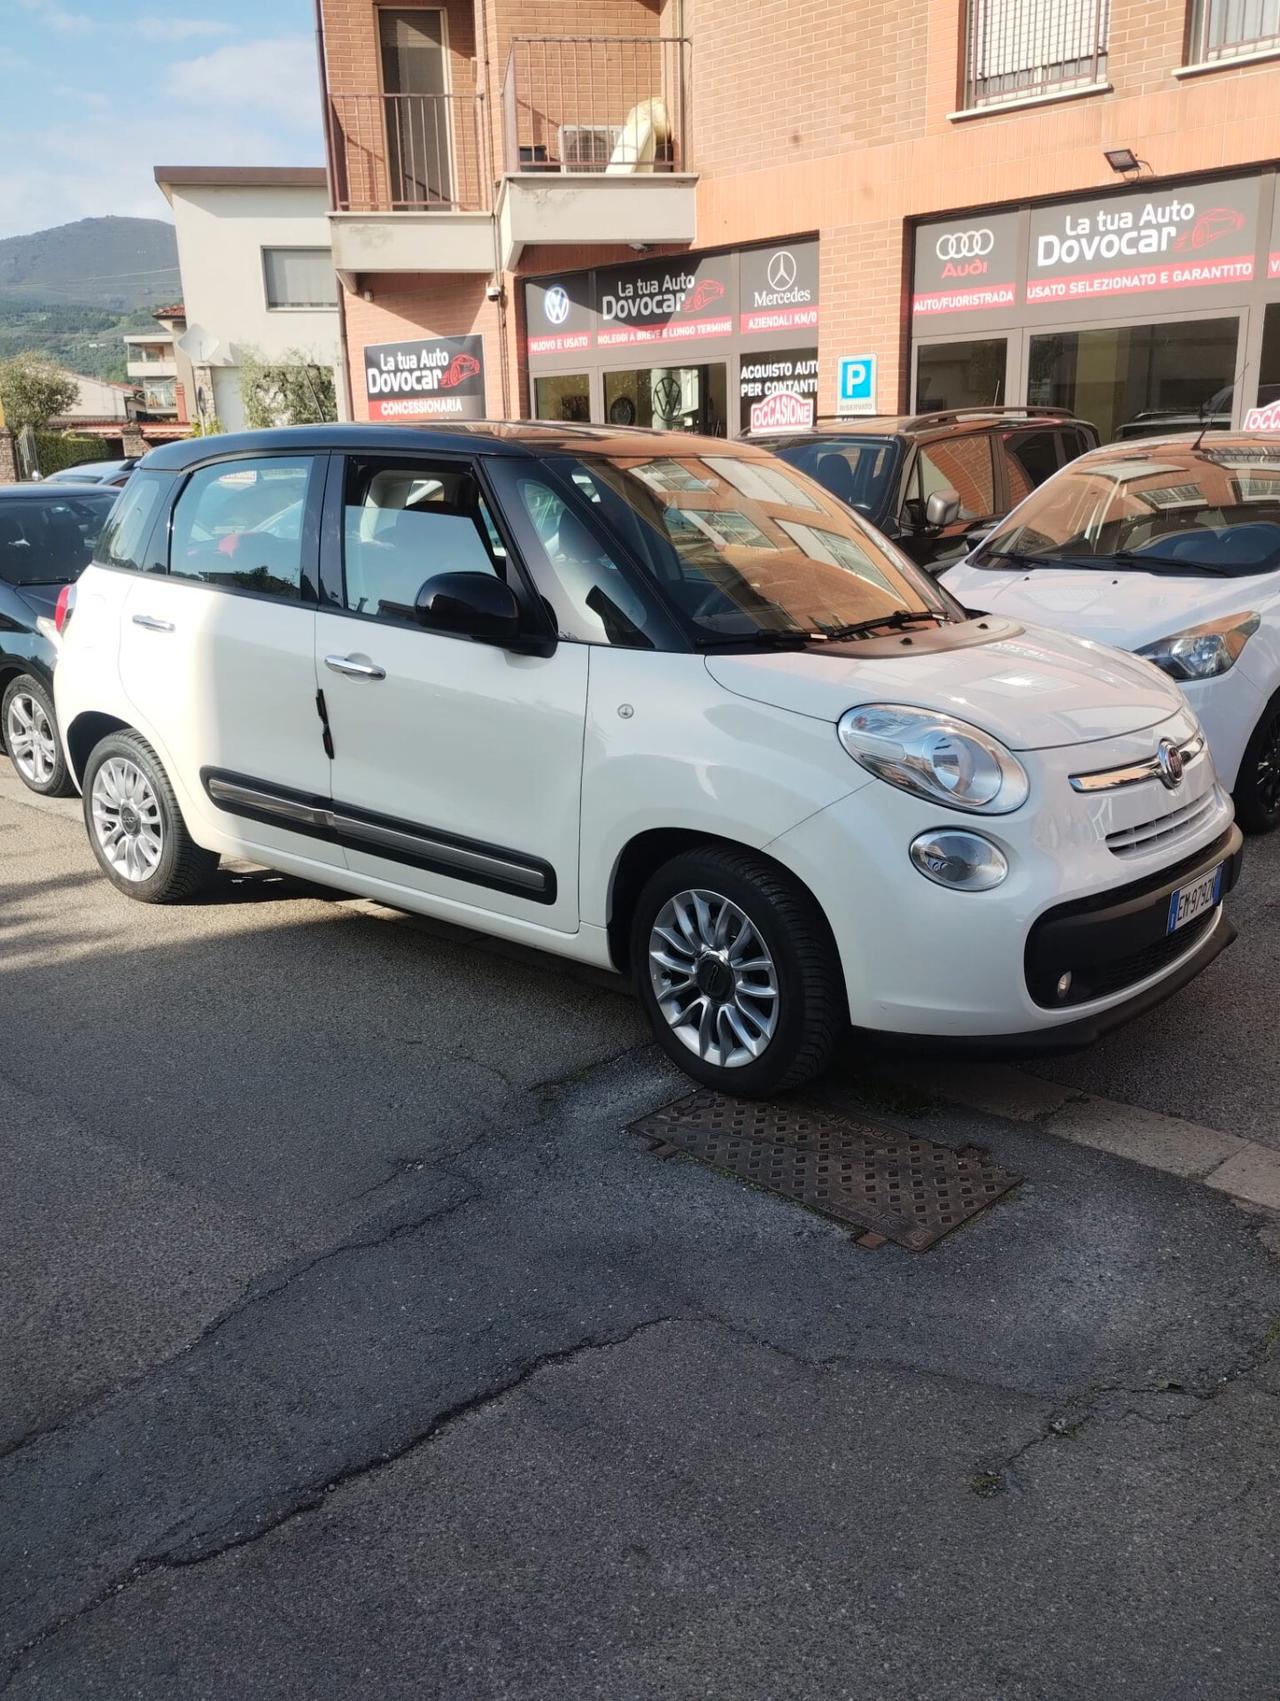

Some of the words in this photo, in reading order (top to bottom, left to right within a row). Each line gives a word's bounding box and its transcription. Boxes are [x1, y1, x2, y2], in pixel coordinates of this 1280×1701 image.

[1065, 215, 1090, 236] La
[1097, 209, 1132, 230] tua
[1140, 199, 1195, 226] Auto
[1037, 226, 1177, 267] Dovocar
[941, 258, 988, 279] Audi
[618, 281, 633, 297] La
[637, 278, 659, 295] tua
[662, 272, 695, 292] Auto
[1027, 283, 1066, 299] USATO
[1069, 274, 1157, 294] SELEZIONATO
[1160, 272, 1169, 284] E
[1173, 263, 1252, 282] GARANTITO
[602, 291, 686, 320] Dovocar
[753, 286, 811, 307] Mercedes
[914, 290, 1014, 312] AUTO/FUORISTRADA
[748, 315, 792, 330] AZIENDALI
[794, 311, 817, 326] KM/0
[531, 338, 555, 352] NUOVO
[557, 338, 563, 350] E
[564, 336, 588, 349] USATO
[597, 332, 628, 345] NOLEGGI
[630, 333, 636, 342] A
[637, 330, 662, 341] BREVE
[662, 329, 668, 339] E
[669, 326, 696, 337] LUNGO
[698, 321, 733, 335] TERMINE
[381, 353, 395, 371] La
[397, 352, 417, 370] tua
[420, 348, 449, 368] Auto
[741, 362, 792, 380] ACQUISTO
[368, 367, 442, 394] Dovocar
[741, 382, 761, 397] PER
[847, 364, 866, 396] P
[381, 398, 463, 416] CONCESSIONARIA
[755, 398, 811, 426] OCCASIONE
